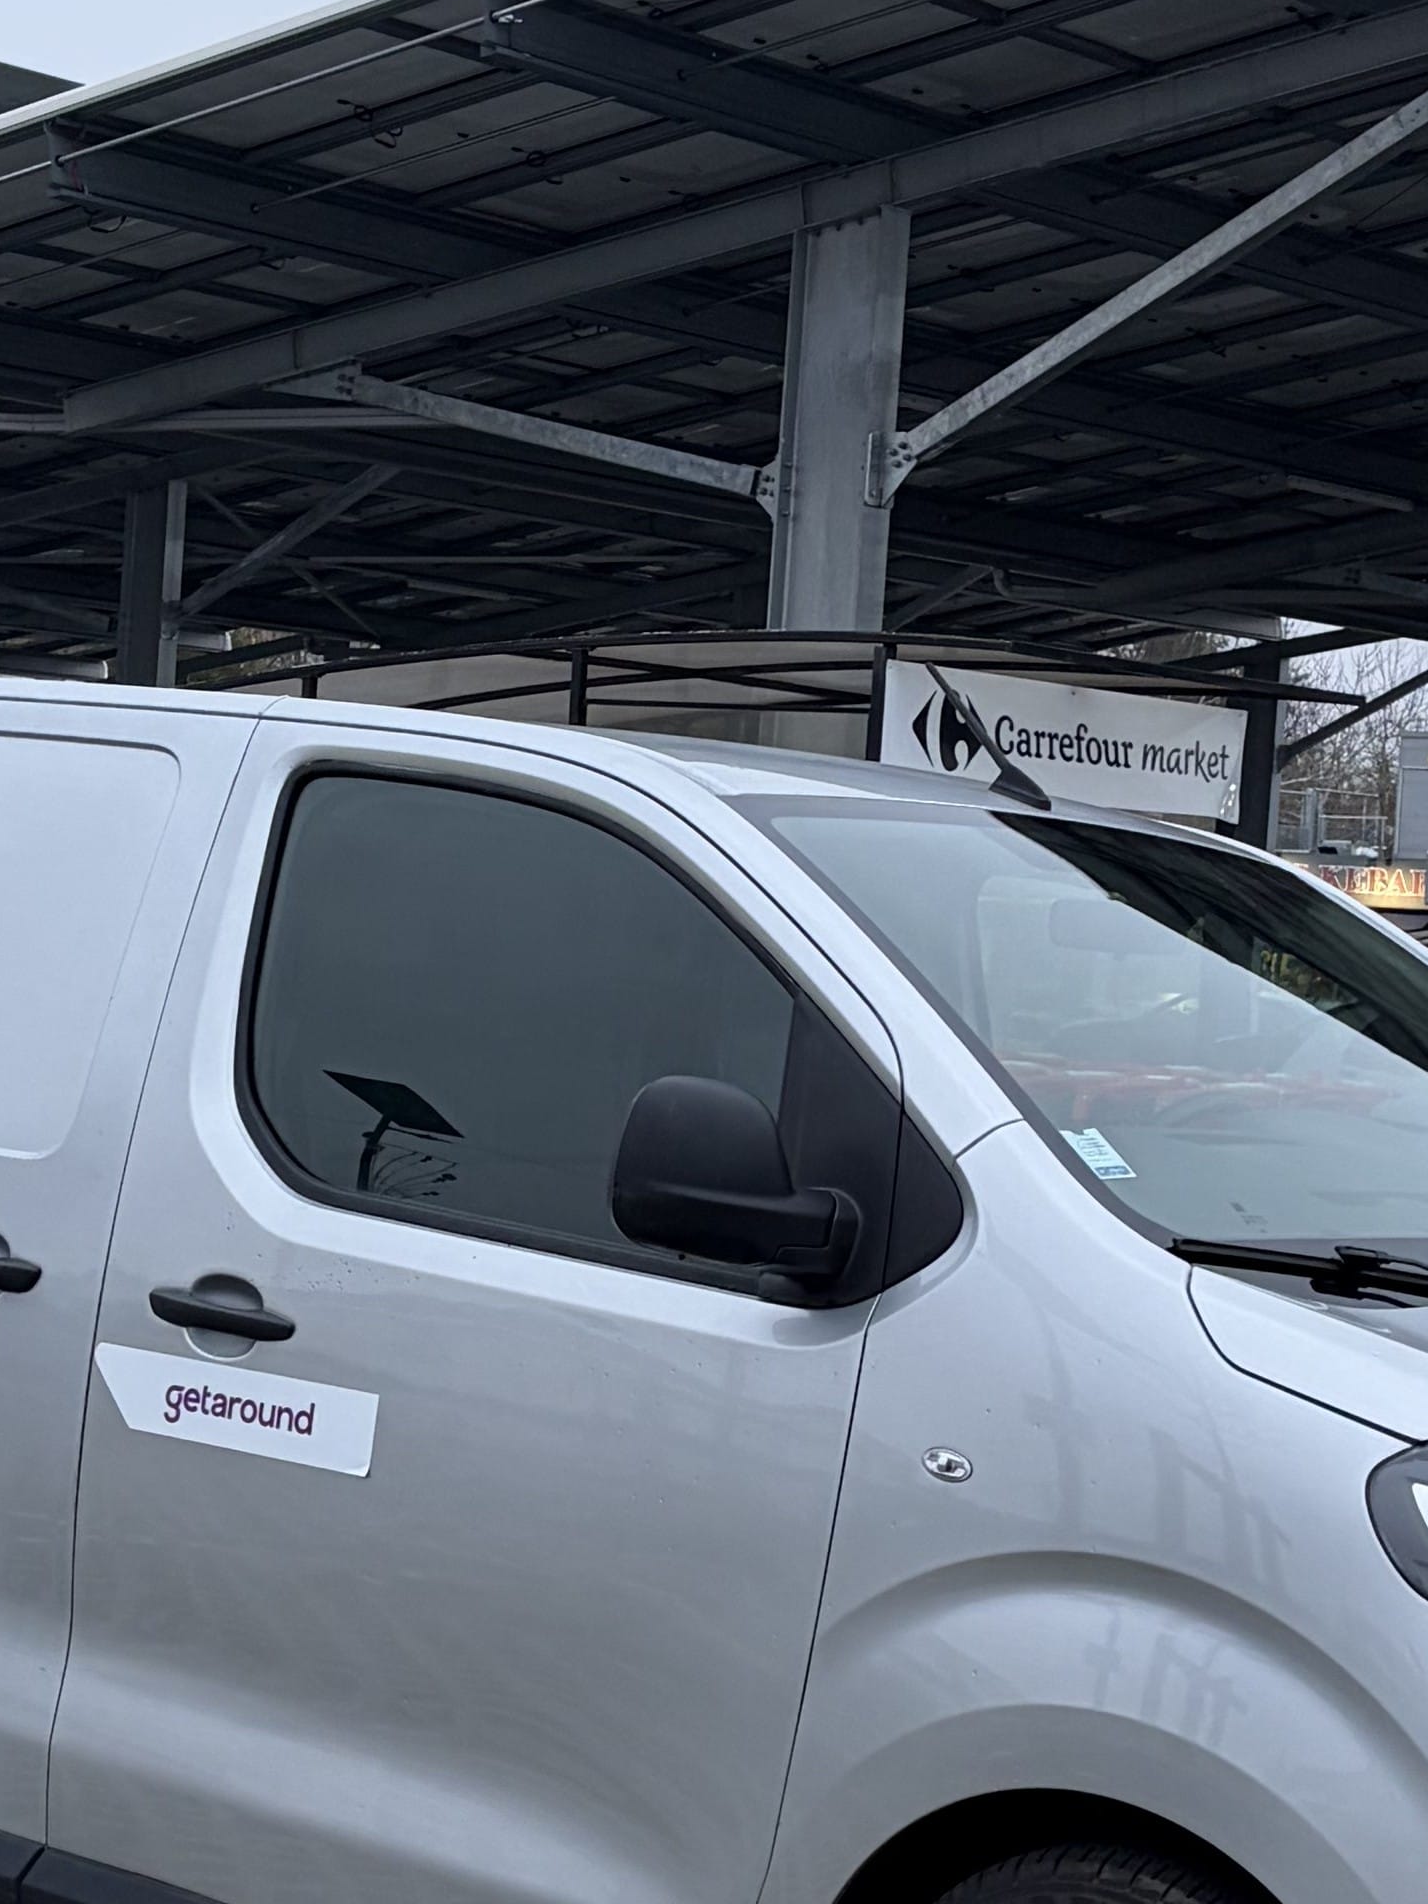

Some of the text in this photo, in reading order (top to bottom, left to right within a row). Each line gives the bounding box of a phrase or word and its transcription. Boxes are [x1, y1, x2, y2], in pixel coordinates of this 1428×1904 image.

[994, 714, 1230, 783] Carrefour market
[163, 1384, 316, 1436] getaround
